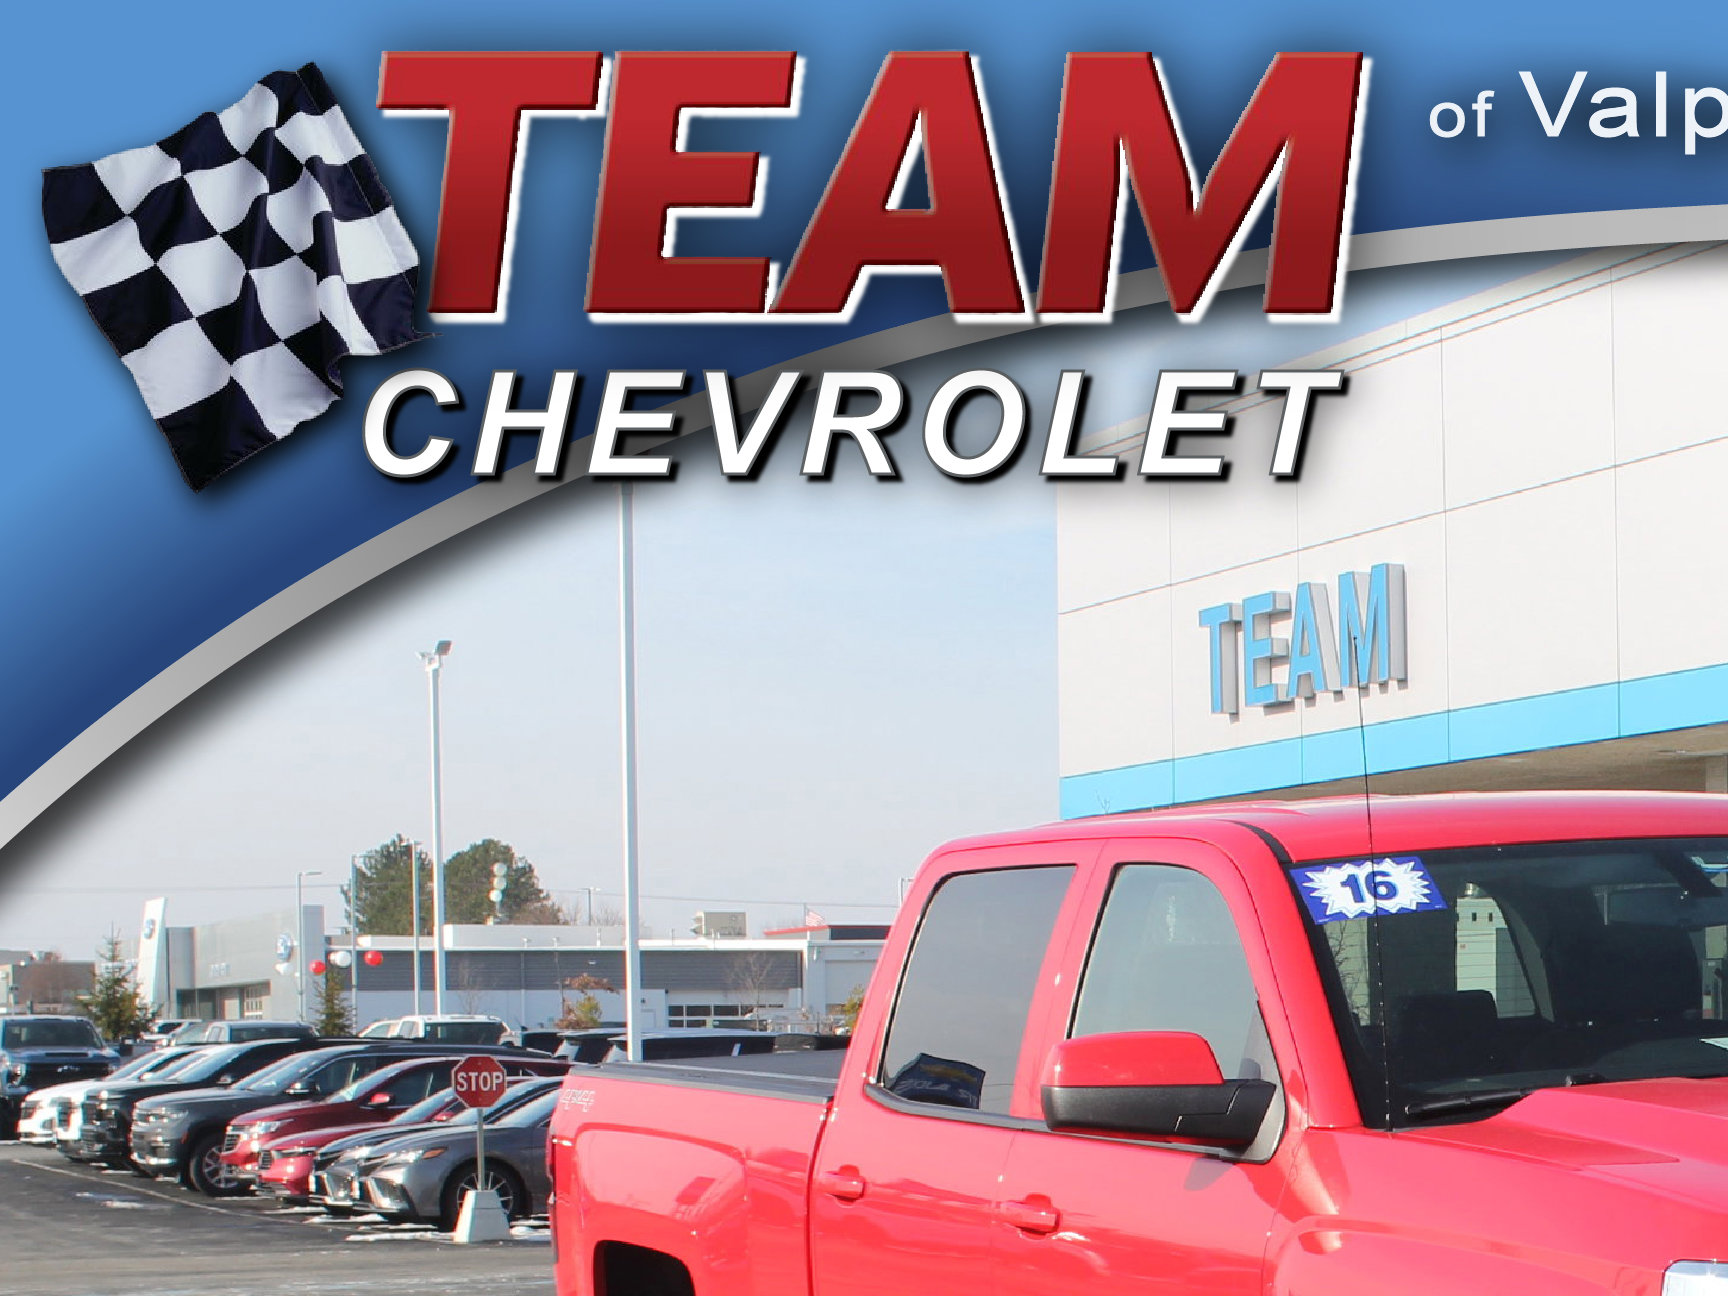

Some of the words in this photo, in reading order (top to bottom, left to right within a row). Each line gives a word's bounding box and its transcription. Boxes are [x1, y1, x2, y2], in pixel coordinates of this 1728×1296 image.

[1199, 562, 1406, 714] TEAM
[1340, 870, 1397, 903] 16
[457, 1071, 503, 1091] STOP
